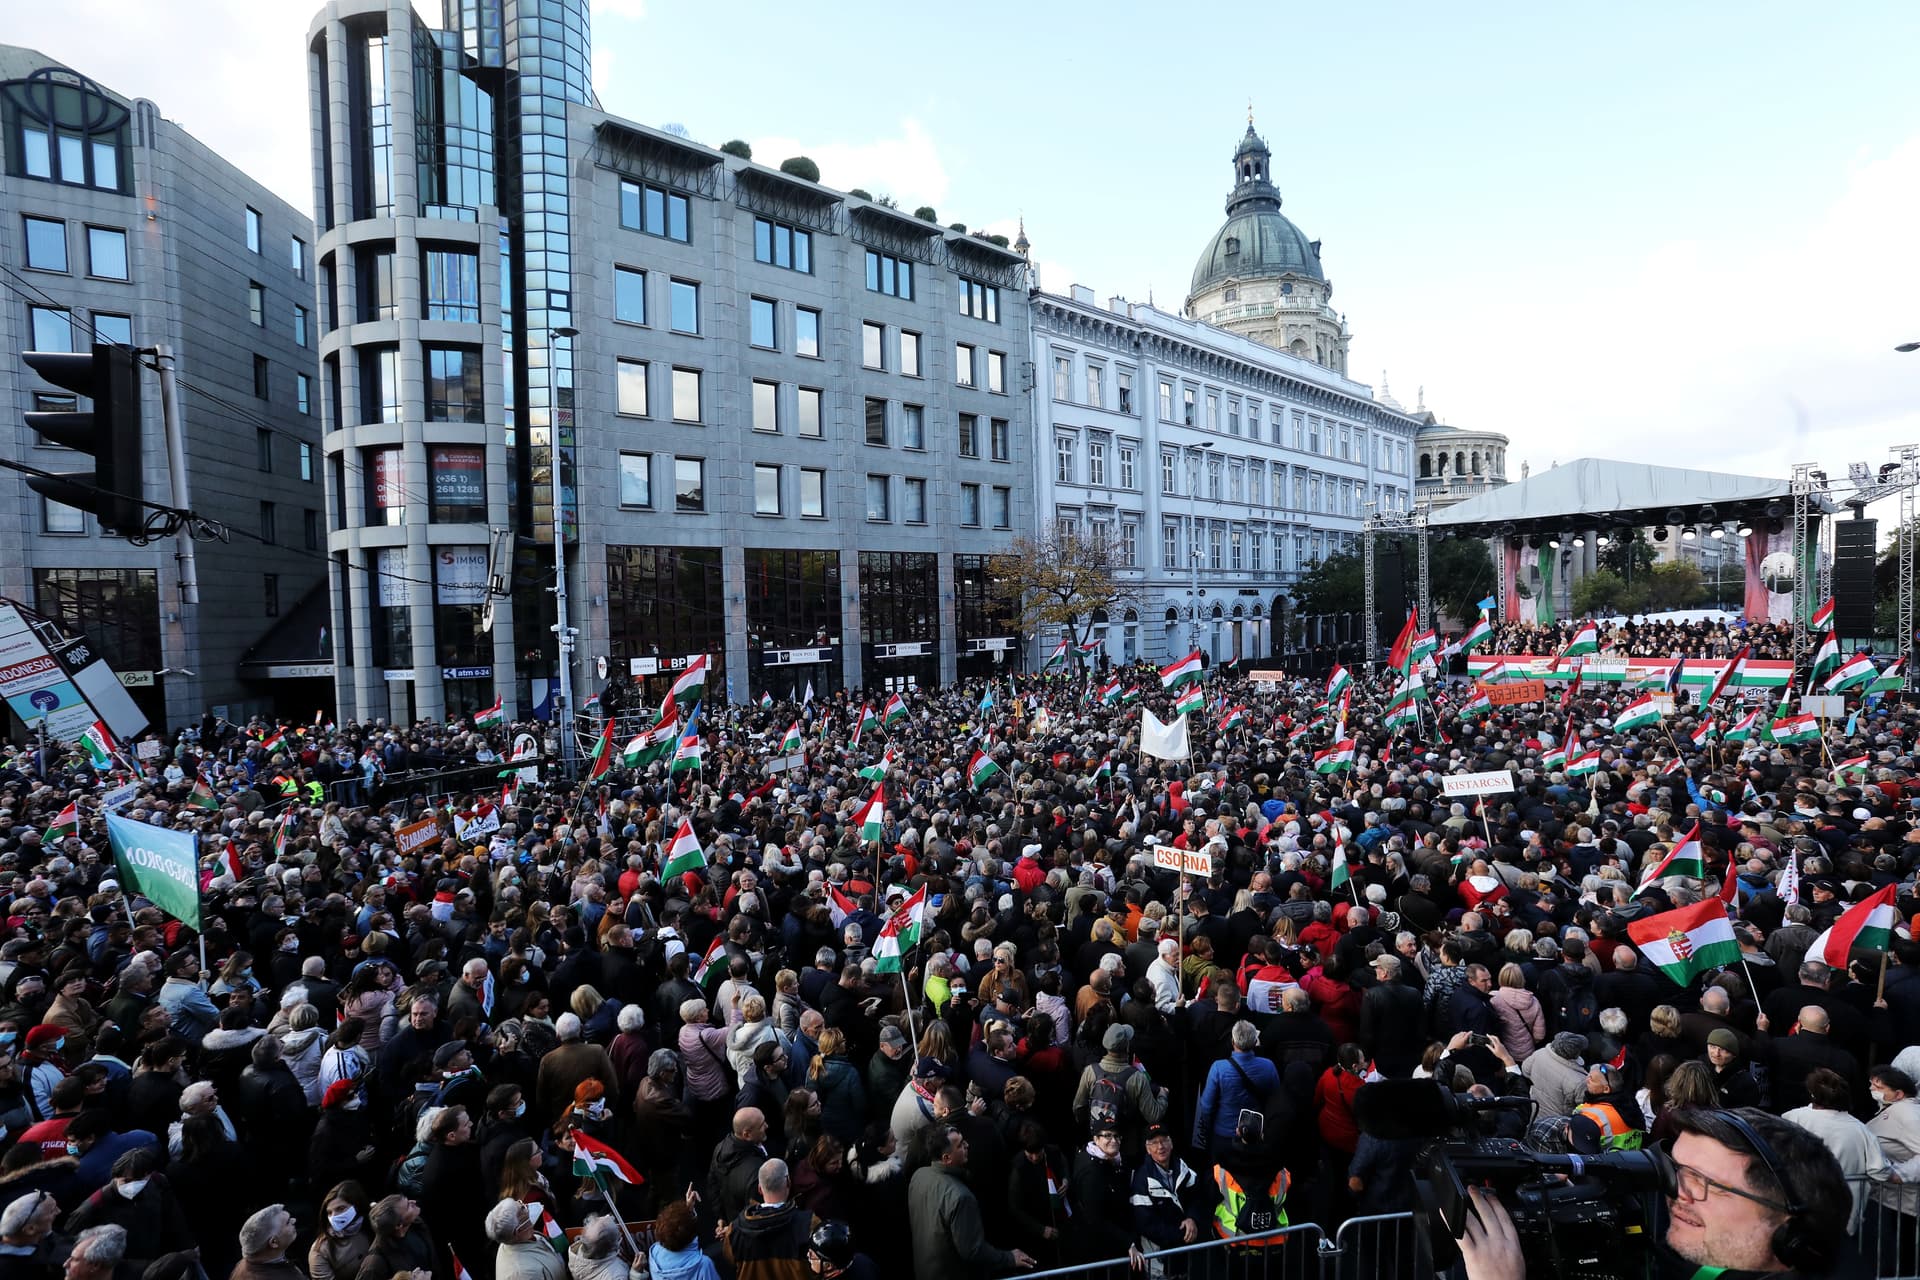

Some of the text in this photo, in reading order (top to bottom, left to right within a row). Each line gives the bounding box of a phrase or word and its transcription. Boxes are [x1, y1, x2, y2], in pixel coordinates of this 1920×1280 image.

[435, 474, 468, 483] (+36 1)
[436, 485, 480, 494] 268 1288
[456, 555, 485, 565] IMMO
[66, 645, 91, 665] apps
[671, 657, 687, 668] BP
[289, 667, 320, 676] CITY
[457, 668, 490, 677] atm 0-24
[1746, 687, 1768, 696] STOP
[1447, 777, 1509, 791] KISTARCSA
[399, 820, 438, 853] SZABADSÁG
[1156, 849, 1209, 873] CSORNA
[1578, 1257, 1599, 1265] Canon
